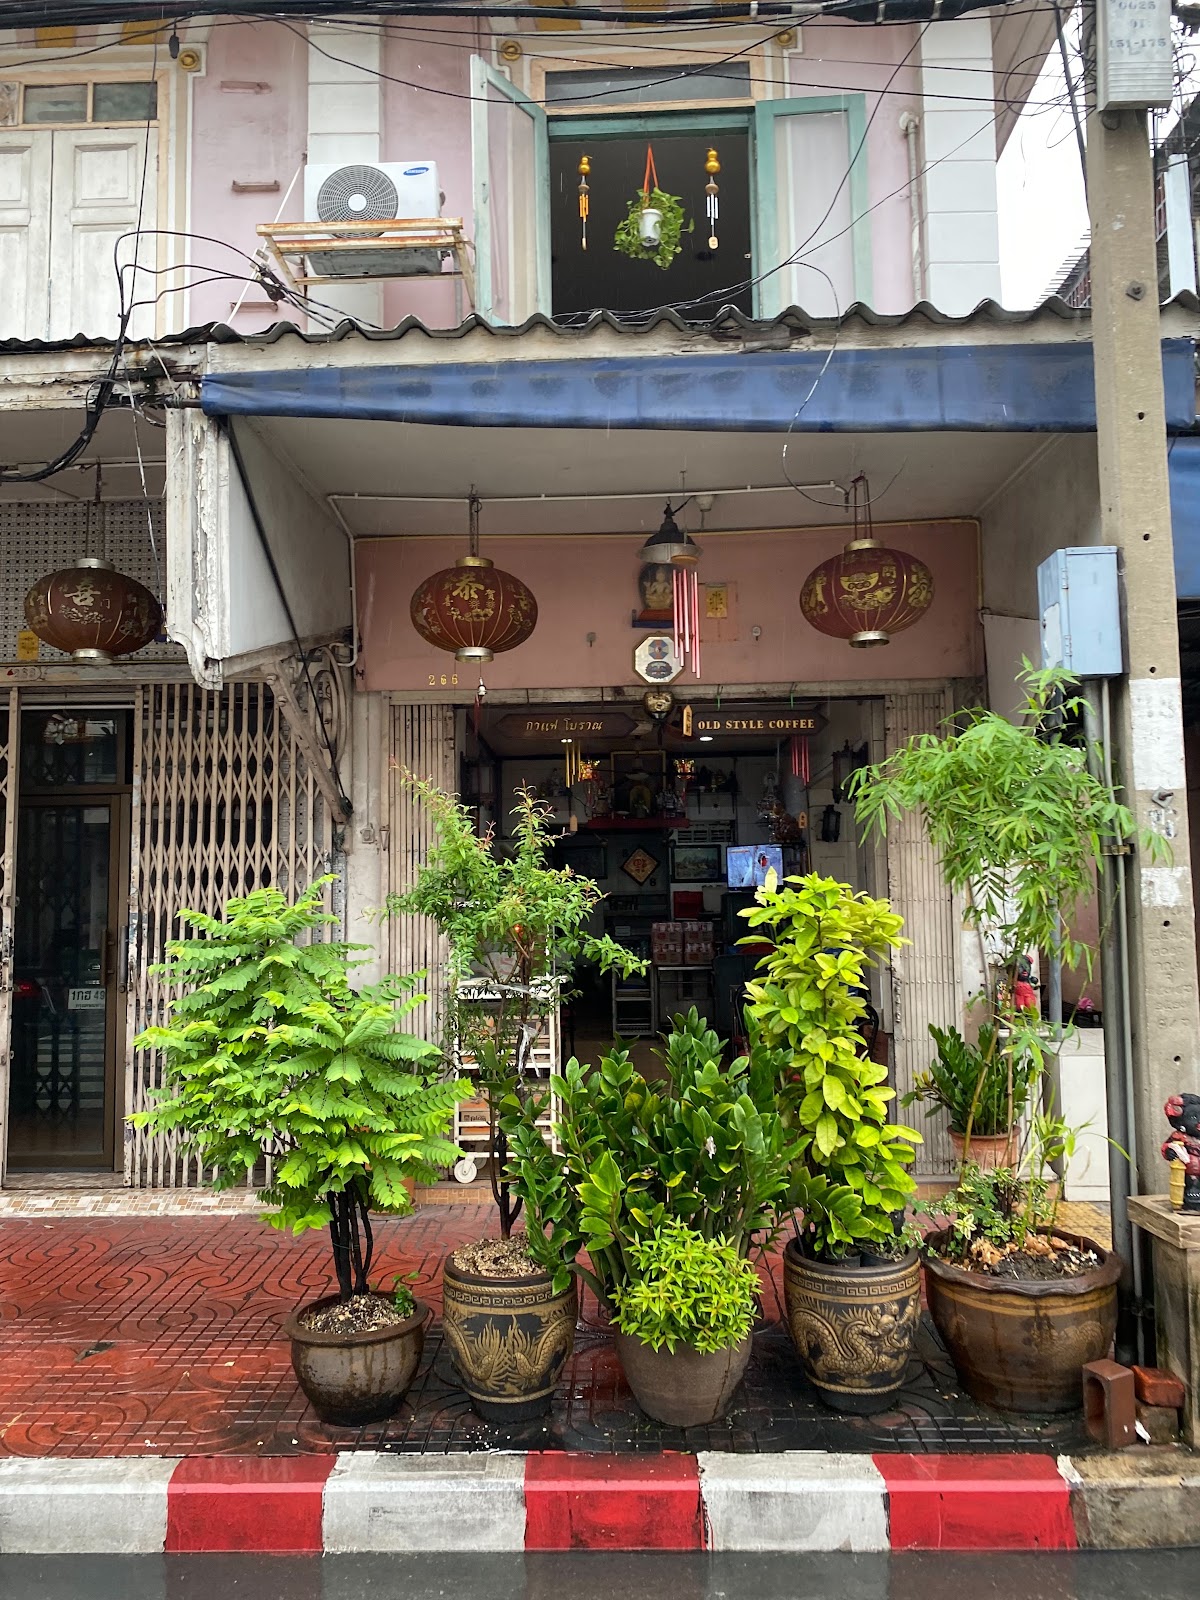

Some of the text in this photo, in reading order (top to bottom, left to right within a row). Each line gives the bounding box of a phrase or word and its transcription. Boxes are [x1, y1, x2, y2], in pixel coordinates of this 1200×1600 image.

[428, 673, 459, 686] 266
[525, 717, 604, 732] กาแฟ โบราณ
[697, 720, 721, 730] OLD
[725, 719, 764, 730] STYLE
[768, 719, 815, 729] COFFEE
